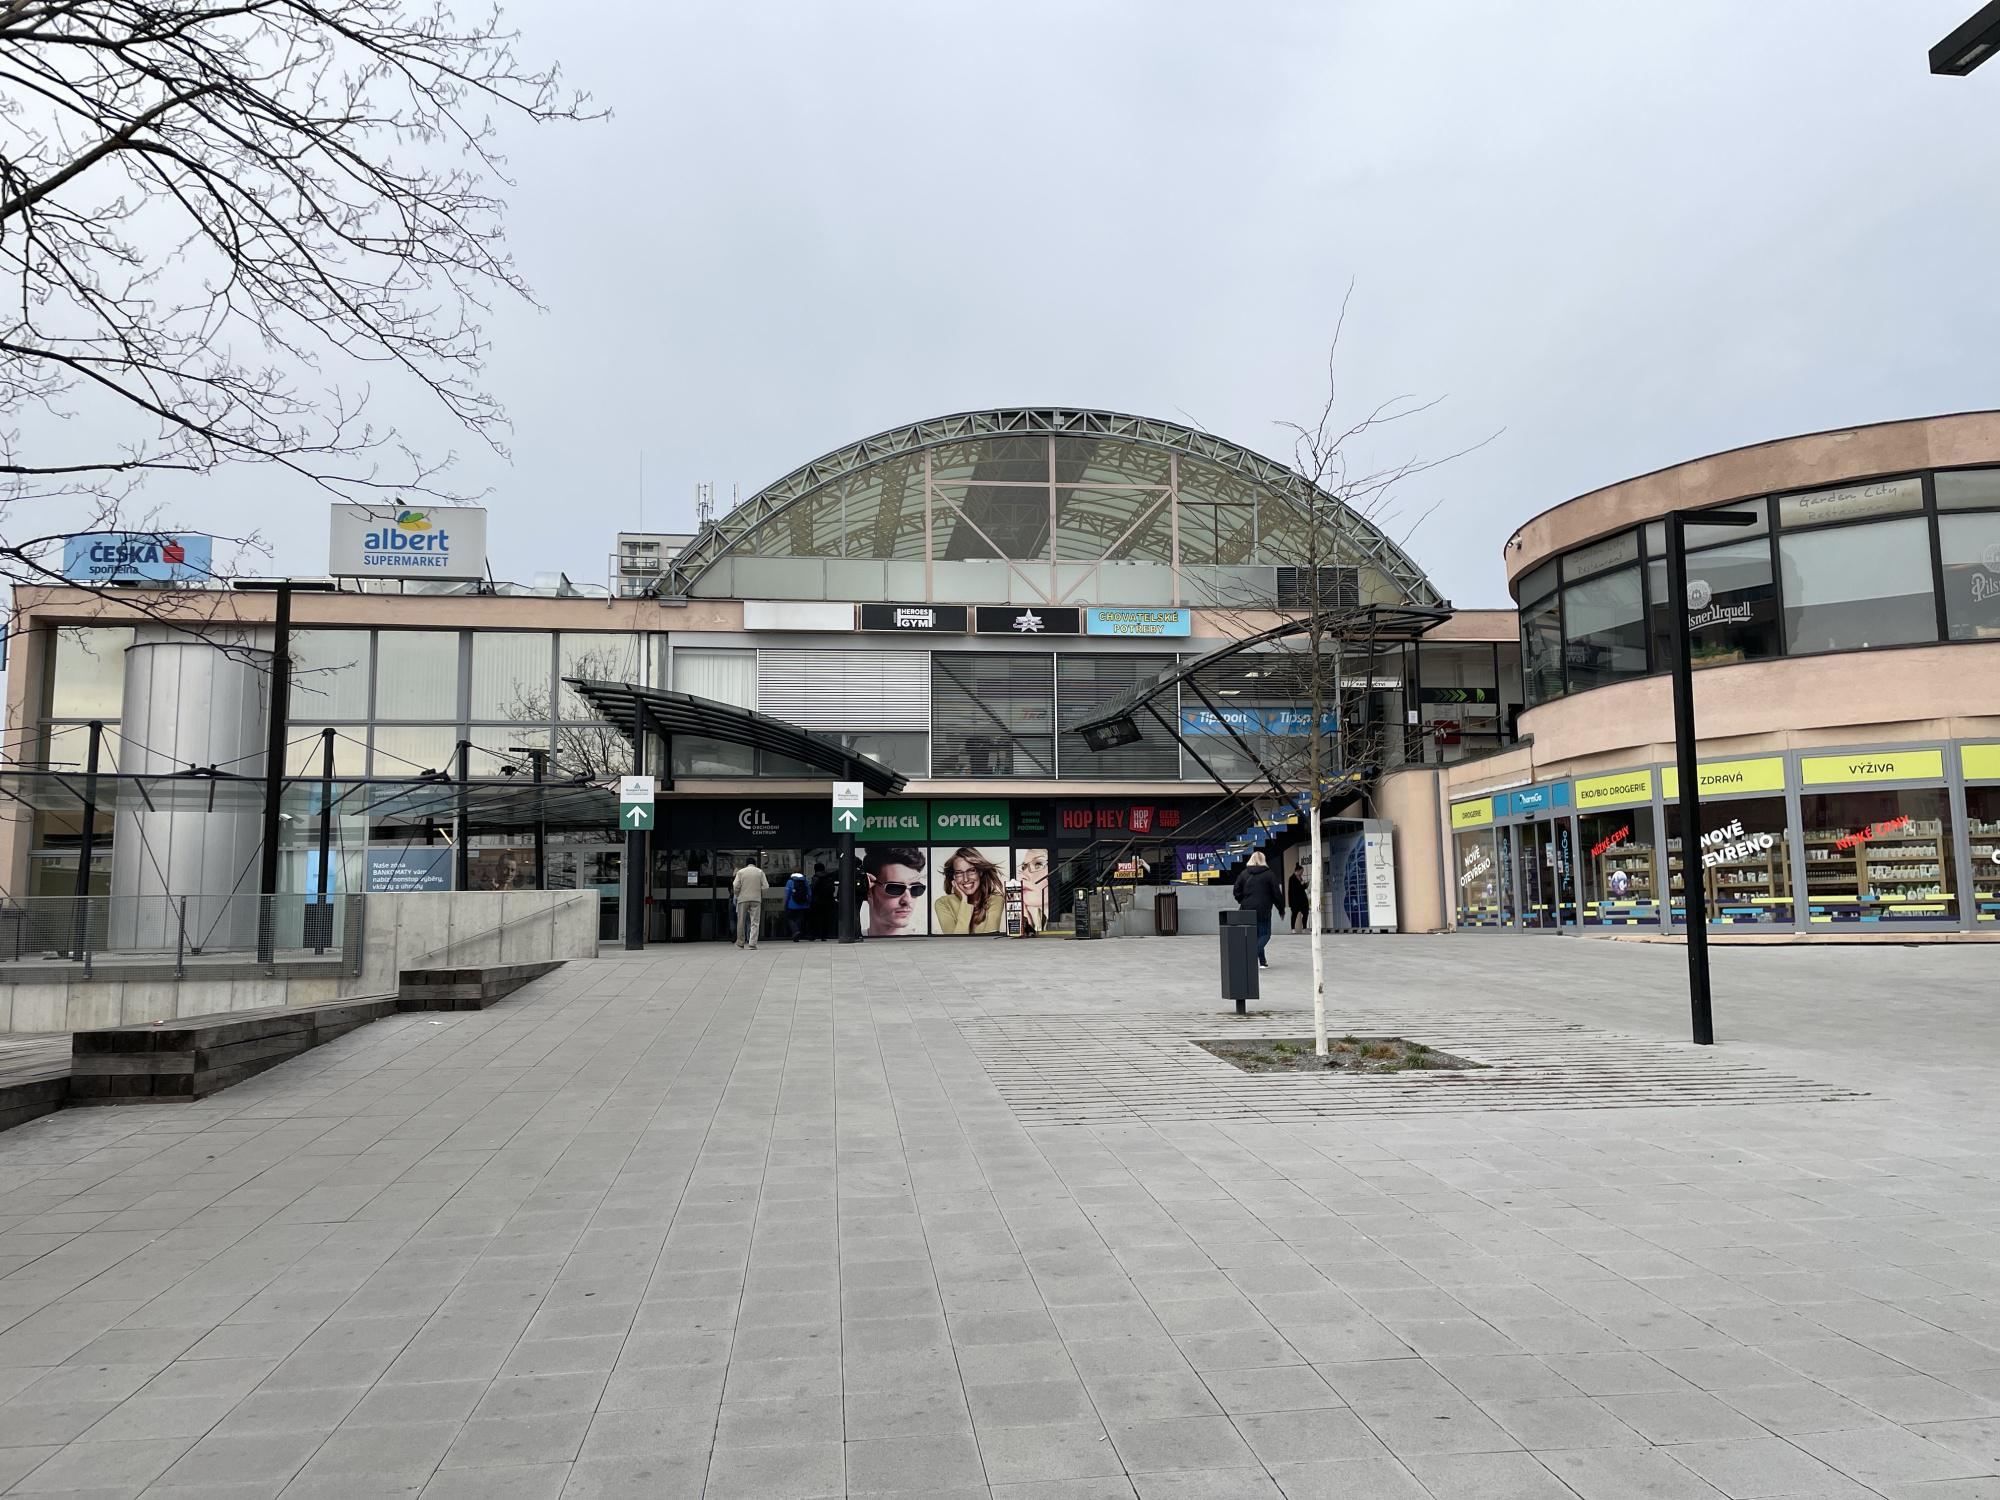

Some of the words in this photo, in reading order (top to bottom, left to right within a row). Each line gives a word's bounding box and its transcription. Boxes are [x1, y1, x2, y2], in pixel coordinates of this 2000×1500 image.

[1800, 492, 1857, 508] Garden
[1864, 485, 1897, 497] City
[364, 528, 449, 551] albert
[90, 541, 159, 563] ČESKÁ
[363, 555, 449, 567] SUPERMARKET
[1971, 572, 2000, 602] Pils
[901, 619, 929, 627] GYM
[1099, 611, 1179, 622] CHOVATELSKÉ
[1687, 611, 1712, 628] lsner
[1114, 623, 1165, 633] POTŘEBY
[1200, 712, 1247, 725] Tipport
[1280, 712, 1327, 725] Tipsprt
[1849, 761, 1894, 774] VÝŽIVA
[1700, 771, 1743, 785] ZDRAVÁ
[1581, 787, 1609, 799] EKO/BIO
[1609, 782, 1646, 796] DROGERIE
[937, 814, 980, 827] OPTIK
[1063, 810, 1093, 829] HOP
[1097, 810, 1125, 829] HEY
[1133, 810, 1149, 819] HOP
[1133, 819, 1148, 829] HEY
[1609, 825, 1630, 845] CENY
[1700, 818, 1744, 848] NOVĚ
[1460, 857, 1491, 887] OTEVŘENO
